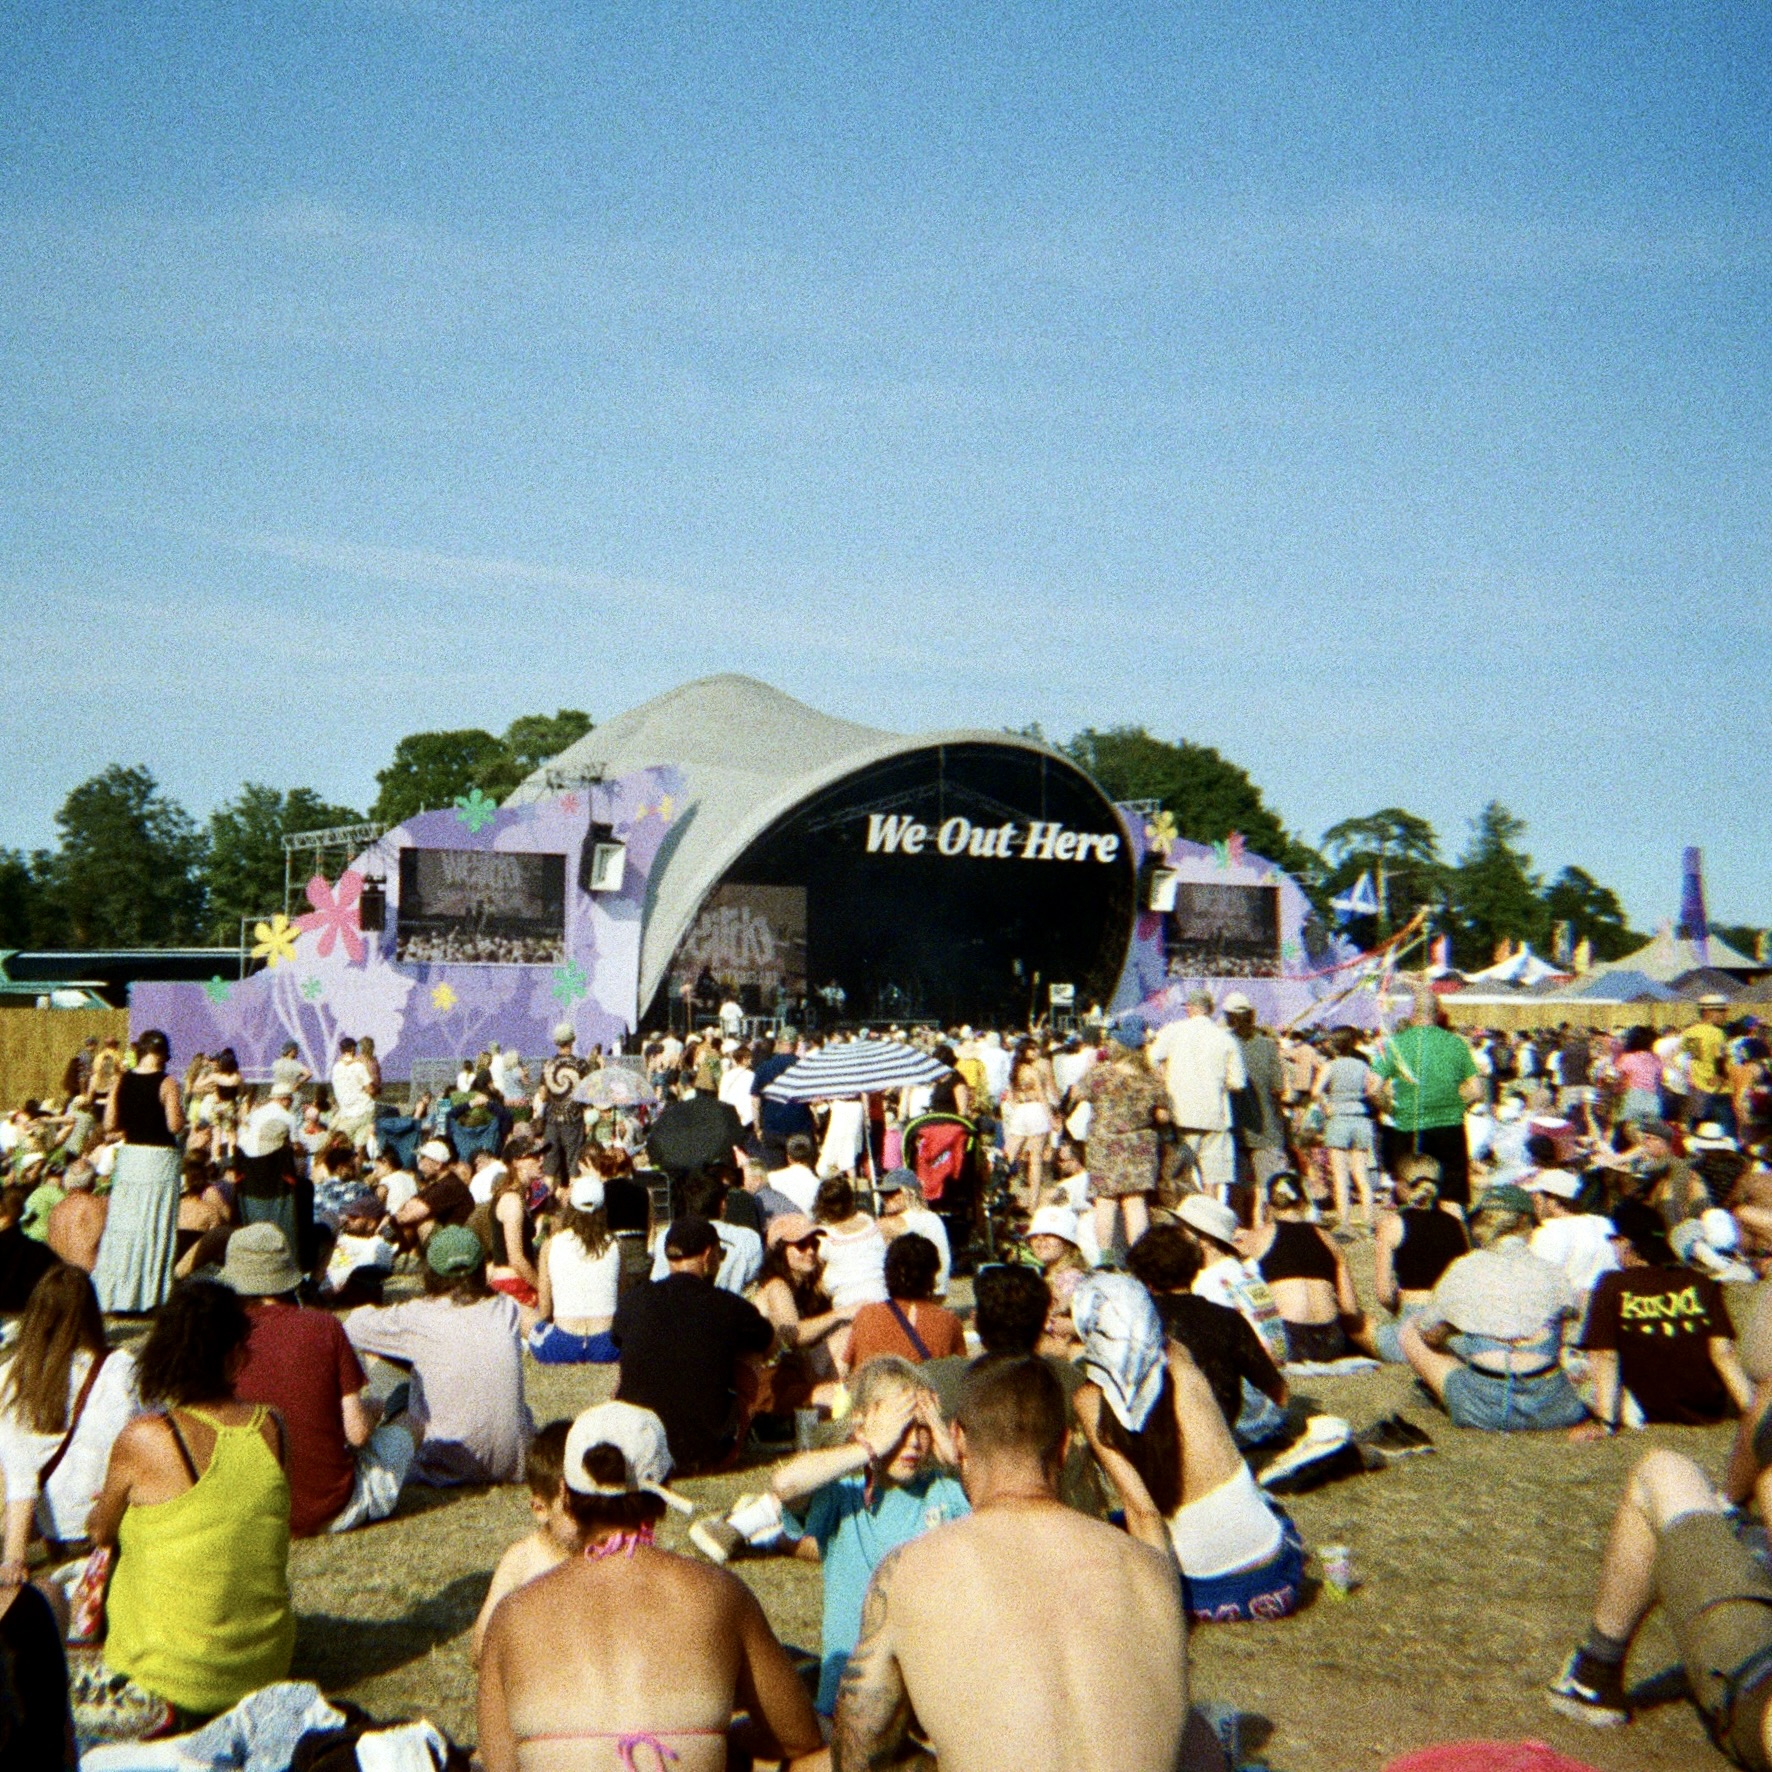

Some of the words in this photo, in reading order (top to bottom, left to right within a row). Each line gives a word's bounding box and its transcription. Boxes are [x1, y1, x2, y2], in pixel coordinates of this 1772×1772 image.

[866, 813, 928, 854] We
[937, 816, 1017, 858] Out
[1021, 821, 1119, 863] Here
